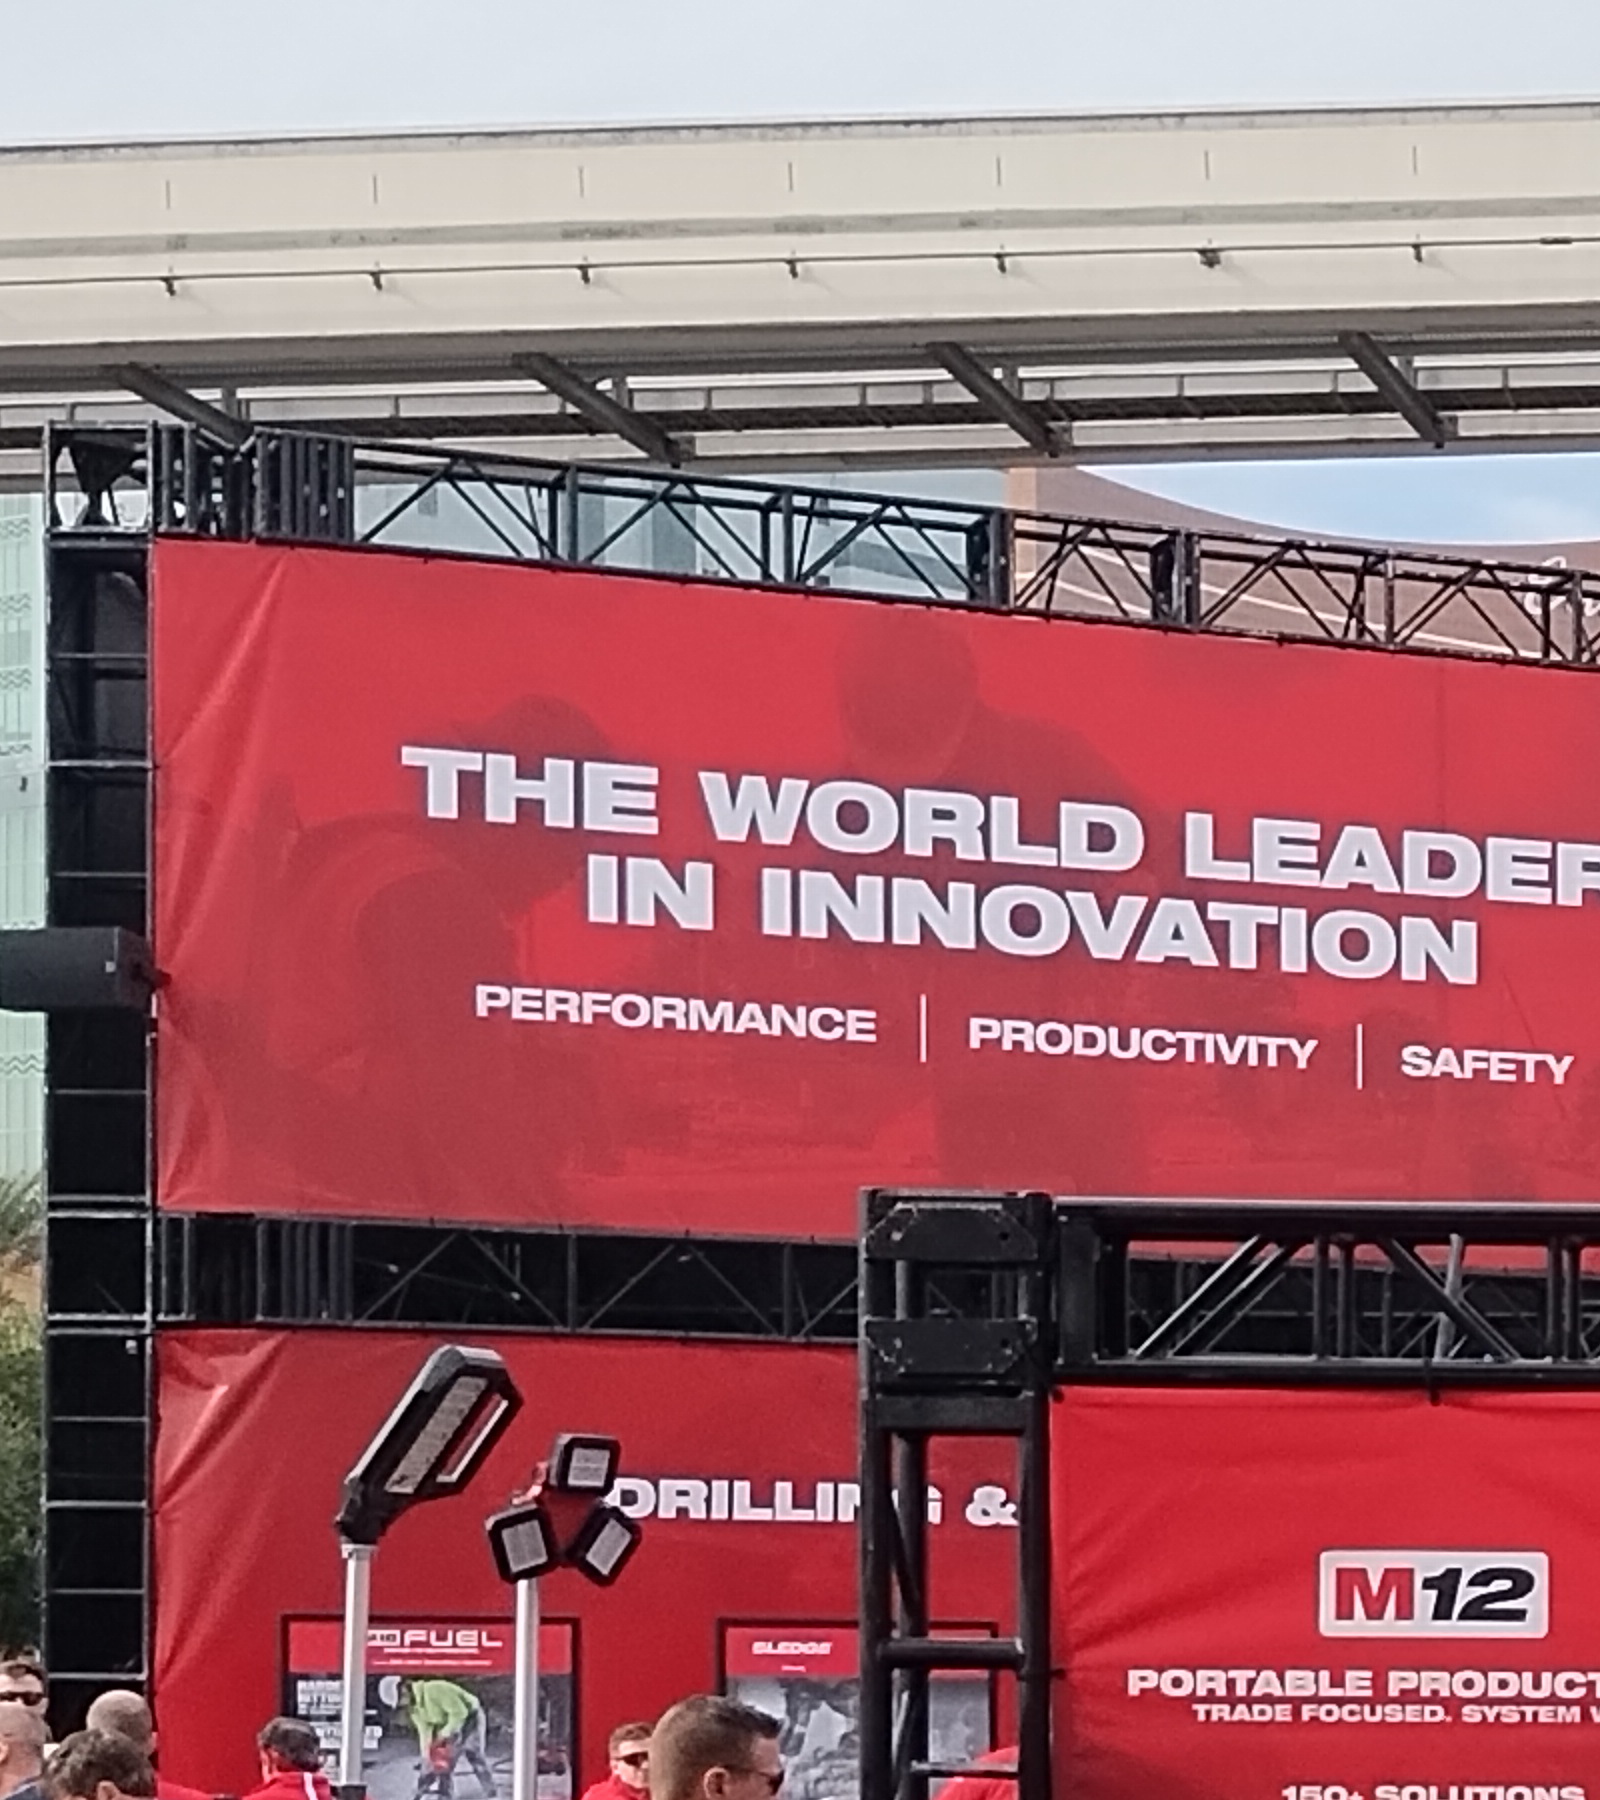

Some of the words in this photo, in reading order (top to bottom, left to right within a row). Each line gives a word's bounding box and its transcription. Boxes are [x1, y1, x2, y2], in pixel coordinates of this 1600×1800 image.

[402, 746, 658, 834] THE
[698, 769, 1147, 873] WORLD
[588, 854, 713, 930] IN
[761, 866, 1478, 987] INNOVATION
[476, 985, 876, 1042] PERFORMANCE
[970, 1018, 1318, 1068] PRODUCTIVITY
[1402, 1046, 1574, 1084] SAFETY
[606, 1478, 941, 1524] DRILLI
[1334, 1567, 1536, 1621] M12
[405, 1629, 503, 1648] FUEL
[1128, 1670, 1372, 1696] PORTABLE
[1192, 1704, 1292, 1721] TRADE
[1302, 1704, 1452, 1722] FOCUSED.
[1462, 1705, 1580, 1722] SYSTEM
